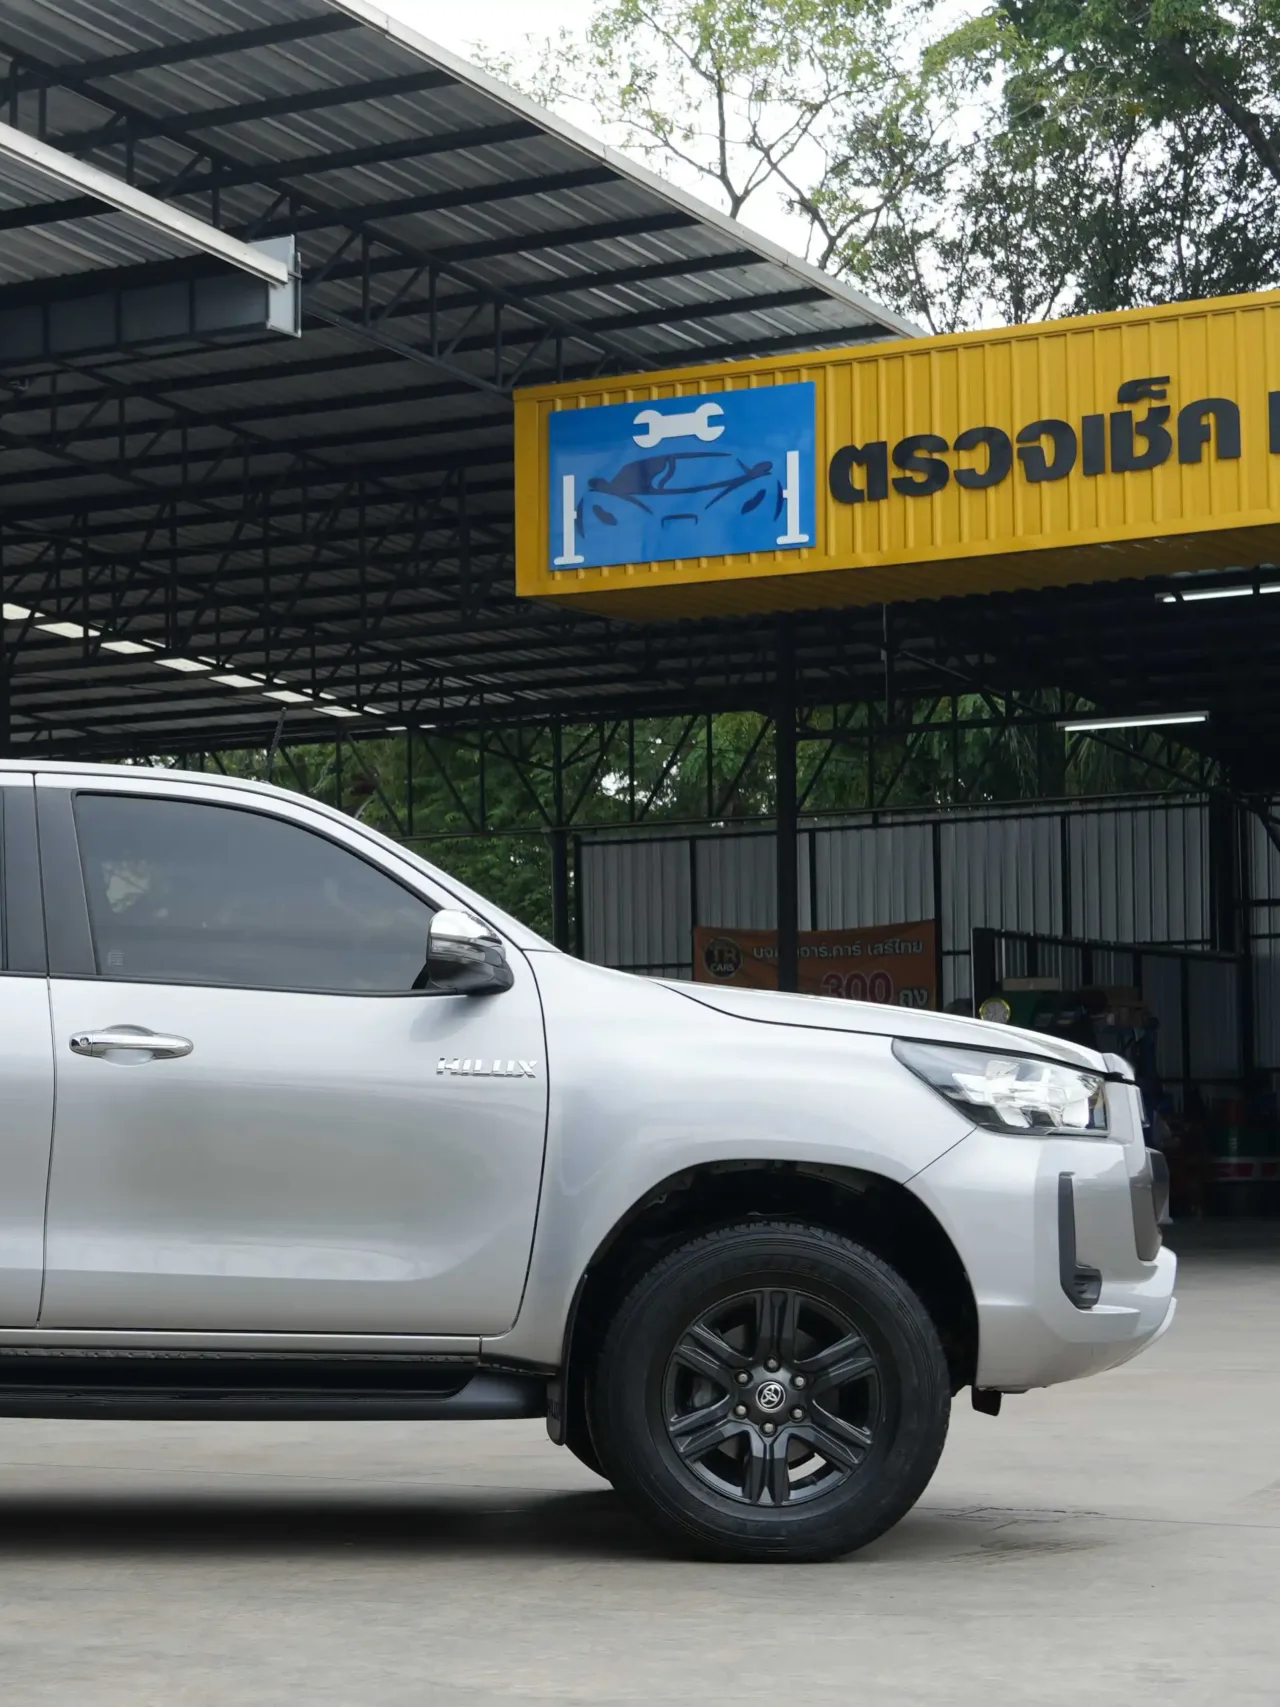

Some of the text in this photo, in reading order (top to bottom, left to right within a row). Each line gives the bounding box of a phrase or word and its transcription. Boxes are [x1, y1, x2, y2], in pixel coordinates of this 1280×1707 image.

[829, 376, 1241, 504] ตรวจเช็ค
[710, 963, 735, 972] CARS
[821, 969, 894, 1004] 300
[436, 1058, 538, 1078] HILUX
